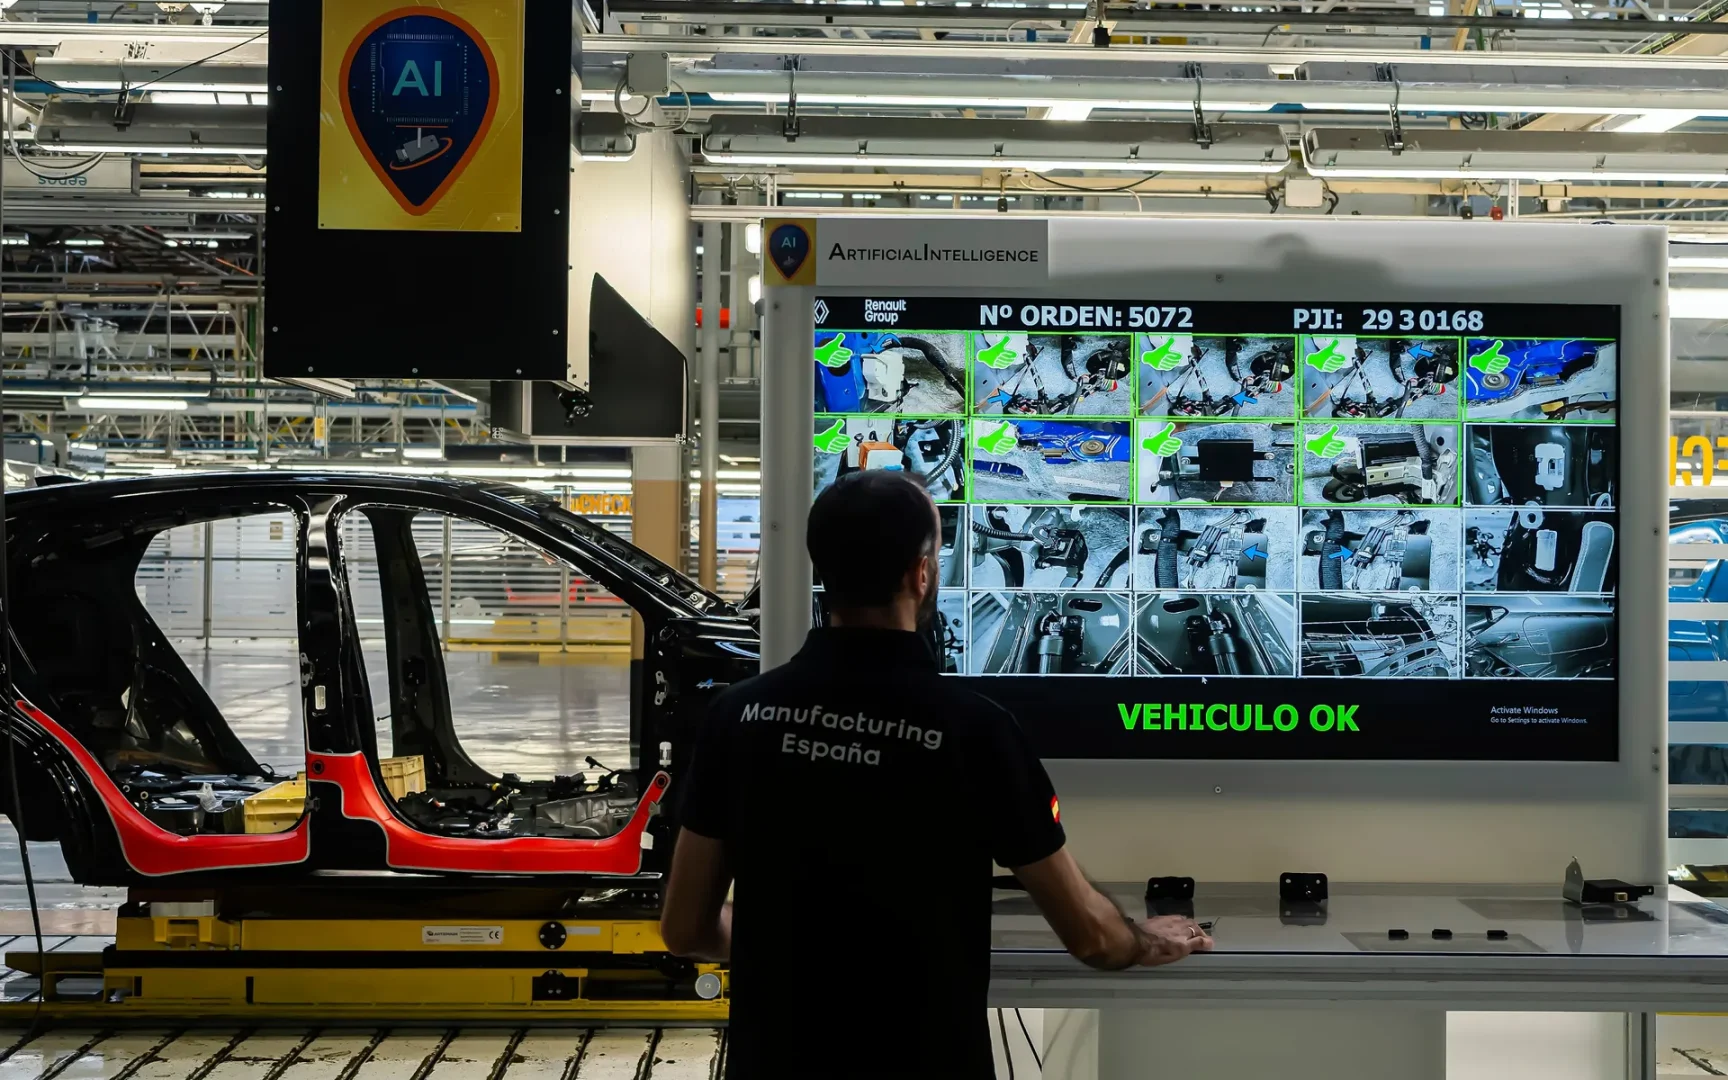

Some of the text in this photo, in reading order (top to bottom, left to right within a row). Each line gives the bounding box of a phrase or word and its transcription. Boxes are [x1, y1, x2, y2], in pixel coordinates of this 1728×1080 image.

[392, 59, 442, 96] AI
[781, 237, 796, 248] AI
[864, 299, 907, 311] Renault
[864, 311, 899, 325] Group
[1020, 305, 1122, 327] ORDEN:
[1128, 306, 1193, 328] 5072
[1293, 308, 1343, 330] PJI:
[1117, 703, 1361, 732] VEHICULO OK
[1490, 706, 1558, 714] Activate Windows
[1490, 716, 1499, 724] Go
[1507, 716, 1530, 725] Settings
[740, 702, 943, 750] Manufacturing
[781, 733, 881, 766] España
